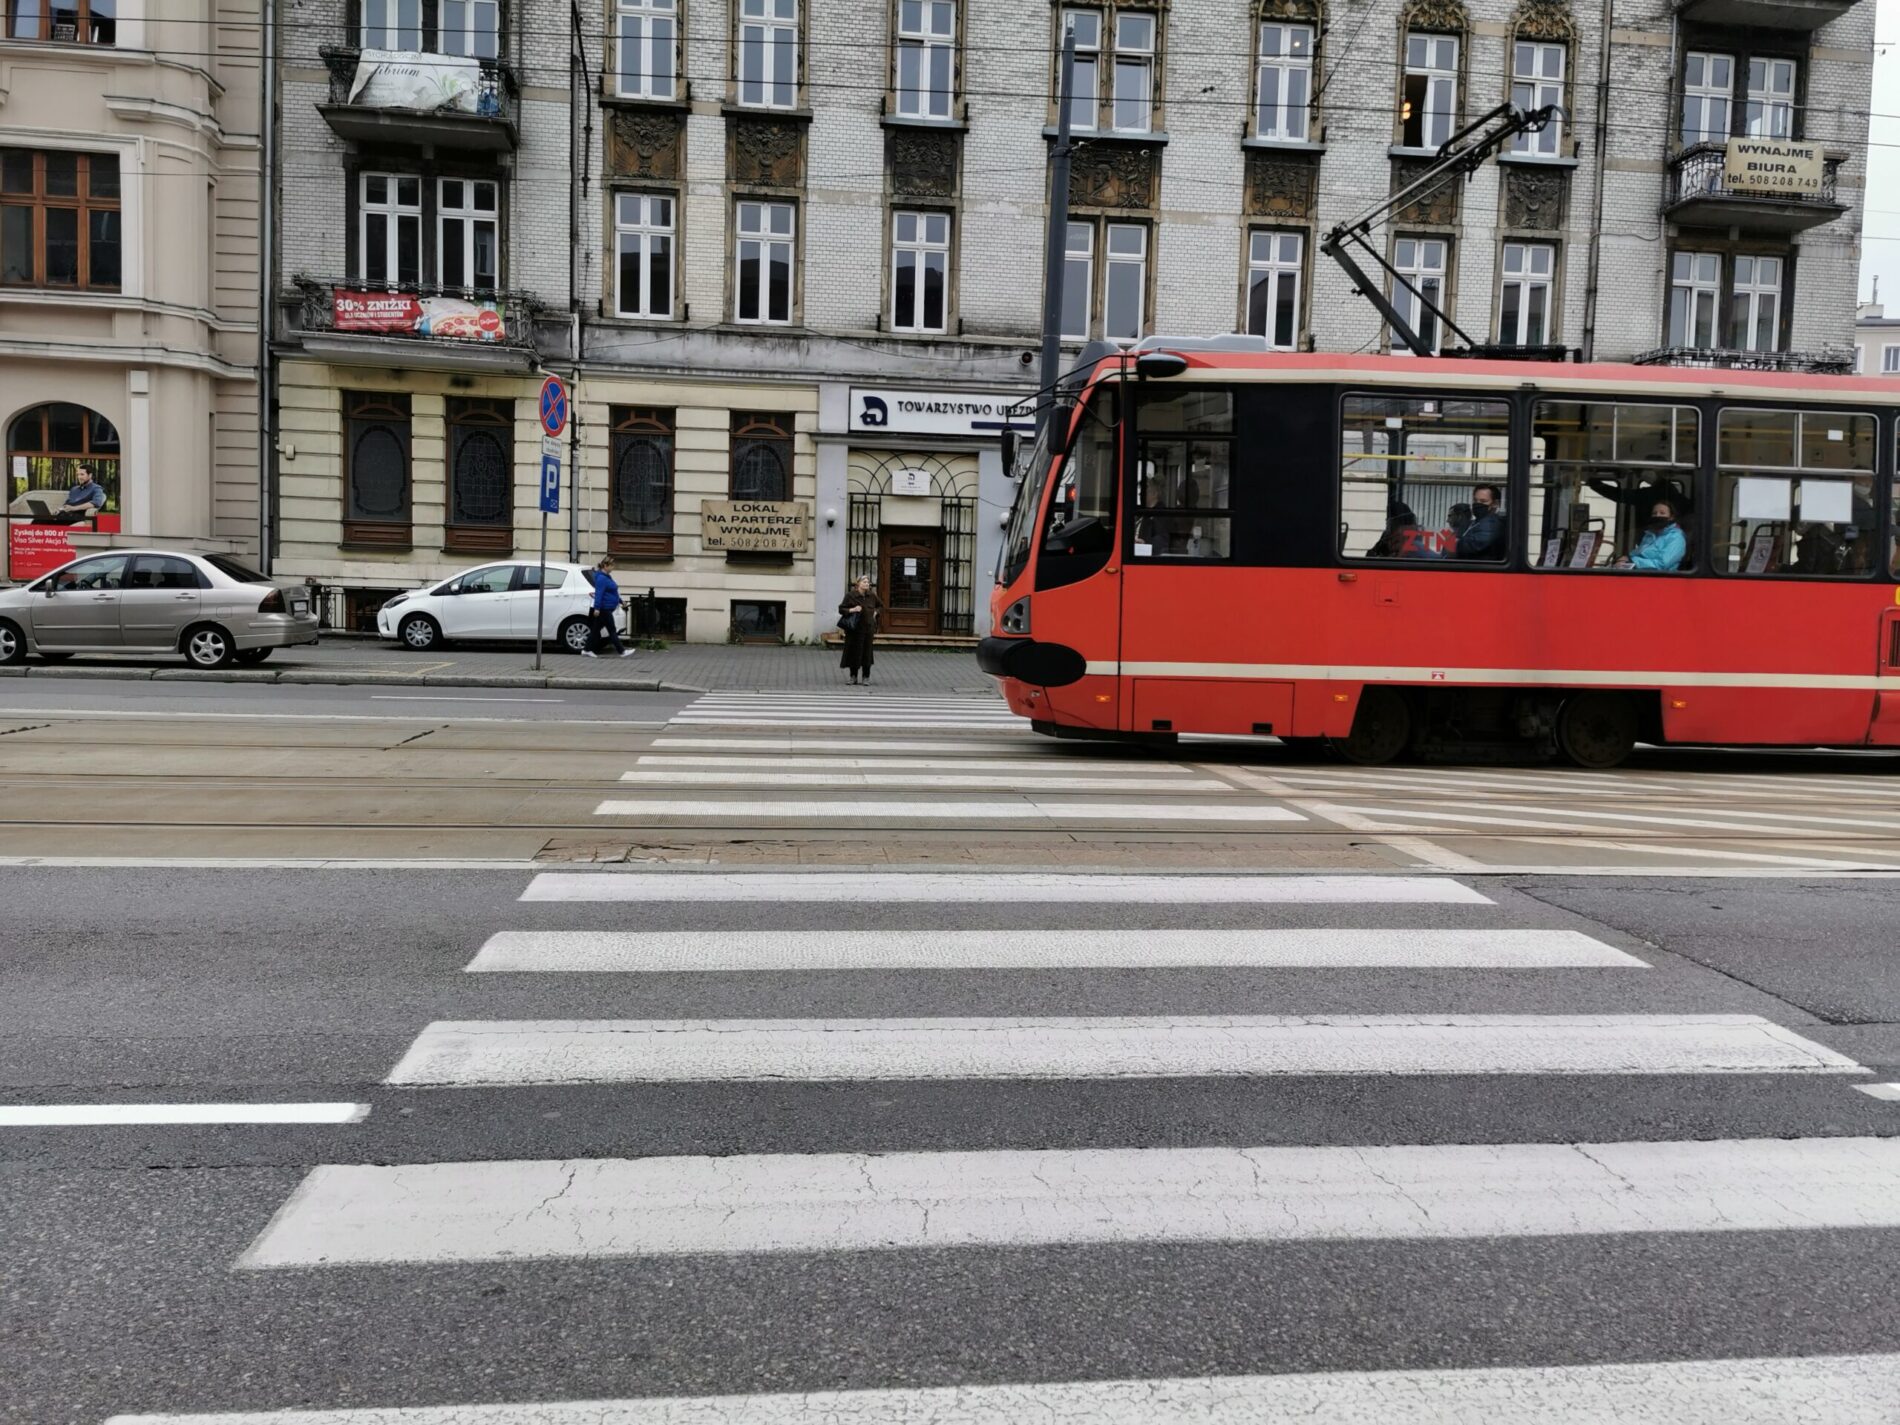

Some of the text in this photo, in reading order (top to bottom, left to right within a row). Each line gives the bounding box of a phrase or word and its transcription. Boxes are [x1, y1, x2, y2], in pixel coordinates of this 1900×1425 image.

[1738, 145, 1813, 160] WYNAJMĘ
[1747, 162, 1797, 174] BIURA
[1728, 173, 1744, 184] tel.
[336, 298, 411, 311] 30% ZNIŻKI
[898, 400, 992, 415] TOWARZYSTWO
[546, 464, 557, 498] P
[733, 504, 779, 513] LOKAL
[707, 515, 803, 525] NA PARTERZE
[14, 529, 35, 537] Zyskaj
[720, 526, 791, 538] WYNAJMĘ
[708, 537, 725, 546] tel.
